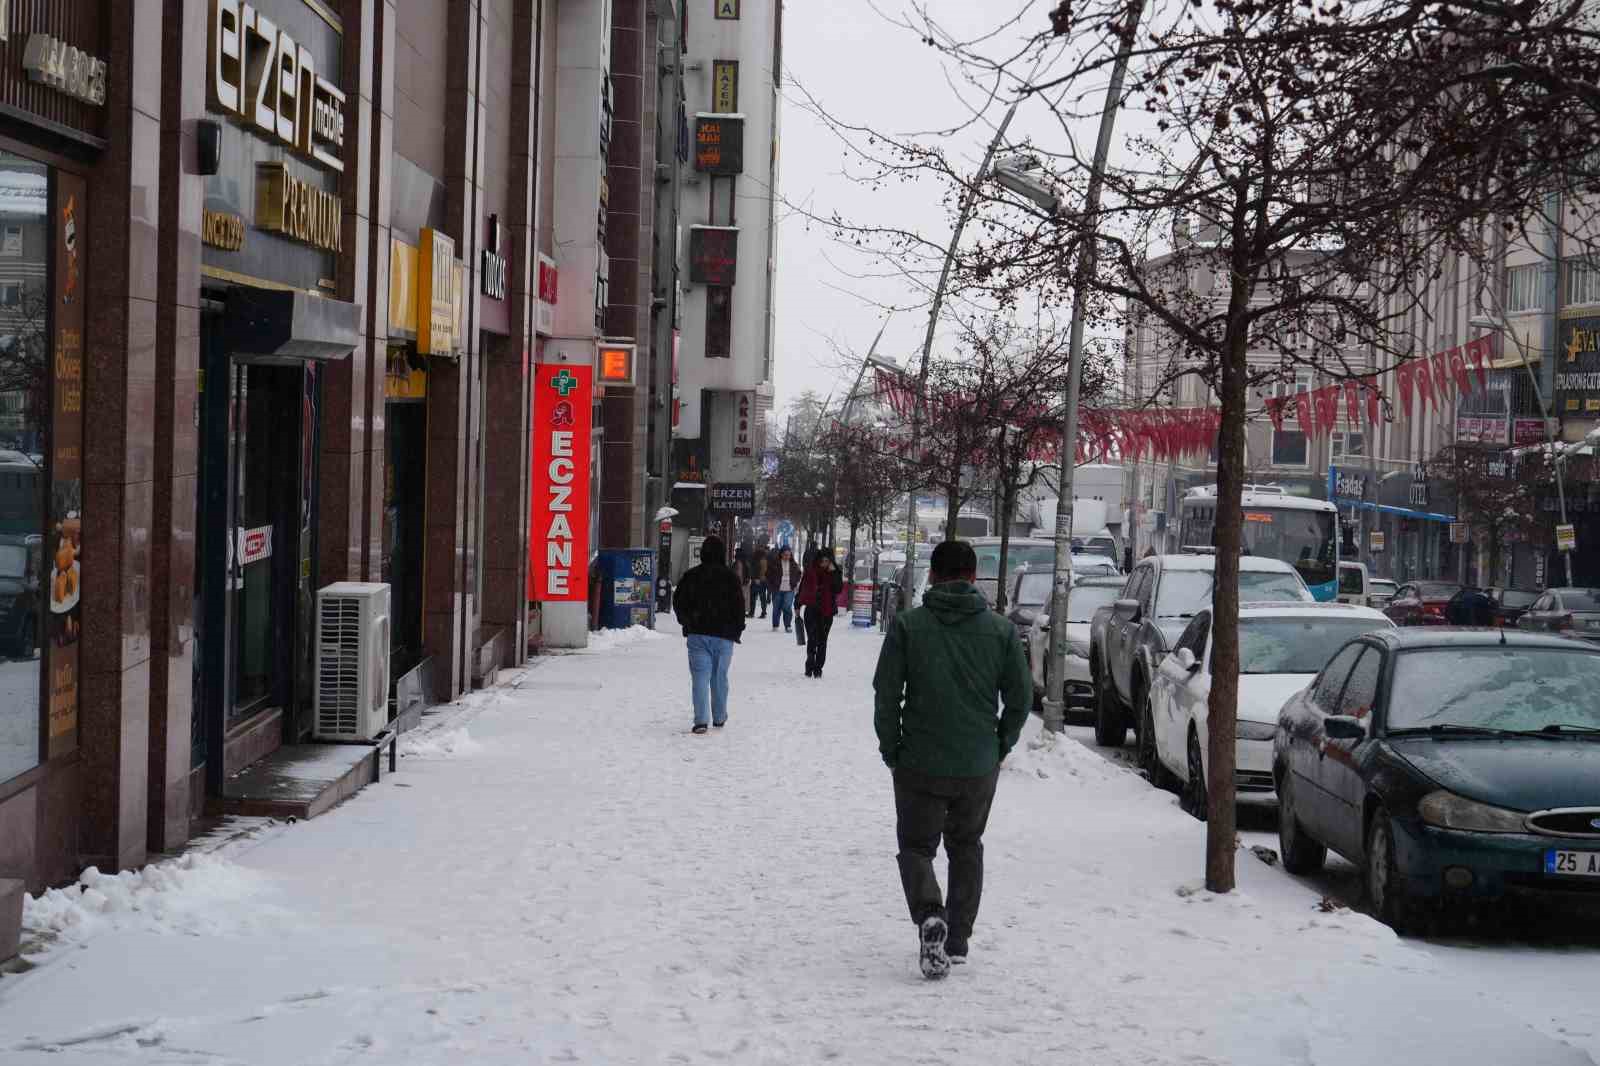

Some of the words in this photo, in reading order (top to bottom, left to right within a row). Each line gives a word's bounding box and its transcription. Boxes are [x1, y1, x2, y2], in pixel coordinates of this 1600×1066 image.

[215, 0, 314, 154] erzen
[315, 95, 344, 147] mobile
[281, 161, 342, 253] PREMIUM
[738, 395, 749, 444] AKSU
[547, 431, 575, 596] ECZANE
[712, 488, 752, 499] ERZEN
[1557, 853, 1577, 872] 25
[1587, 854, 1600, 873] A
